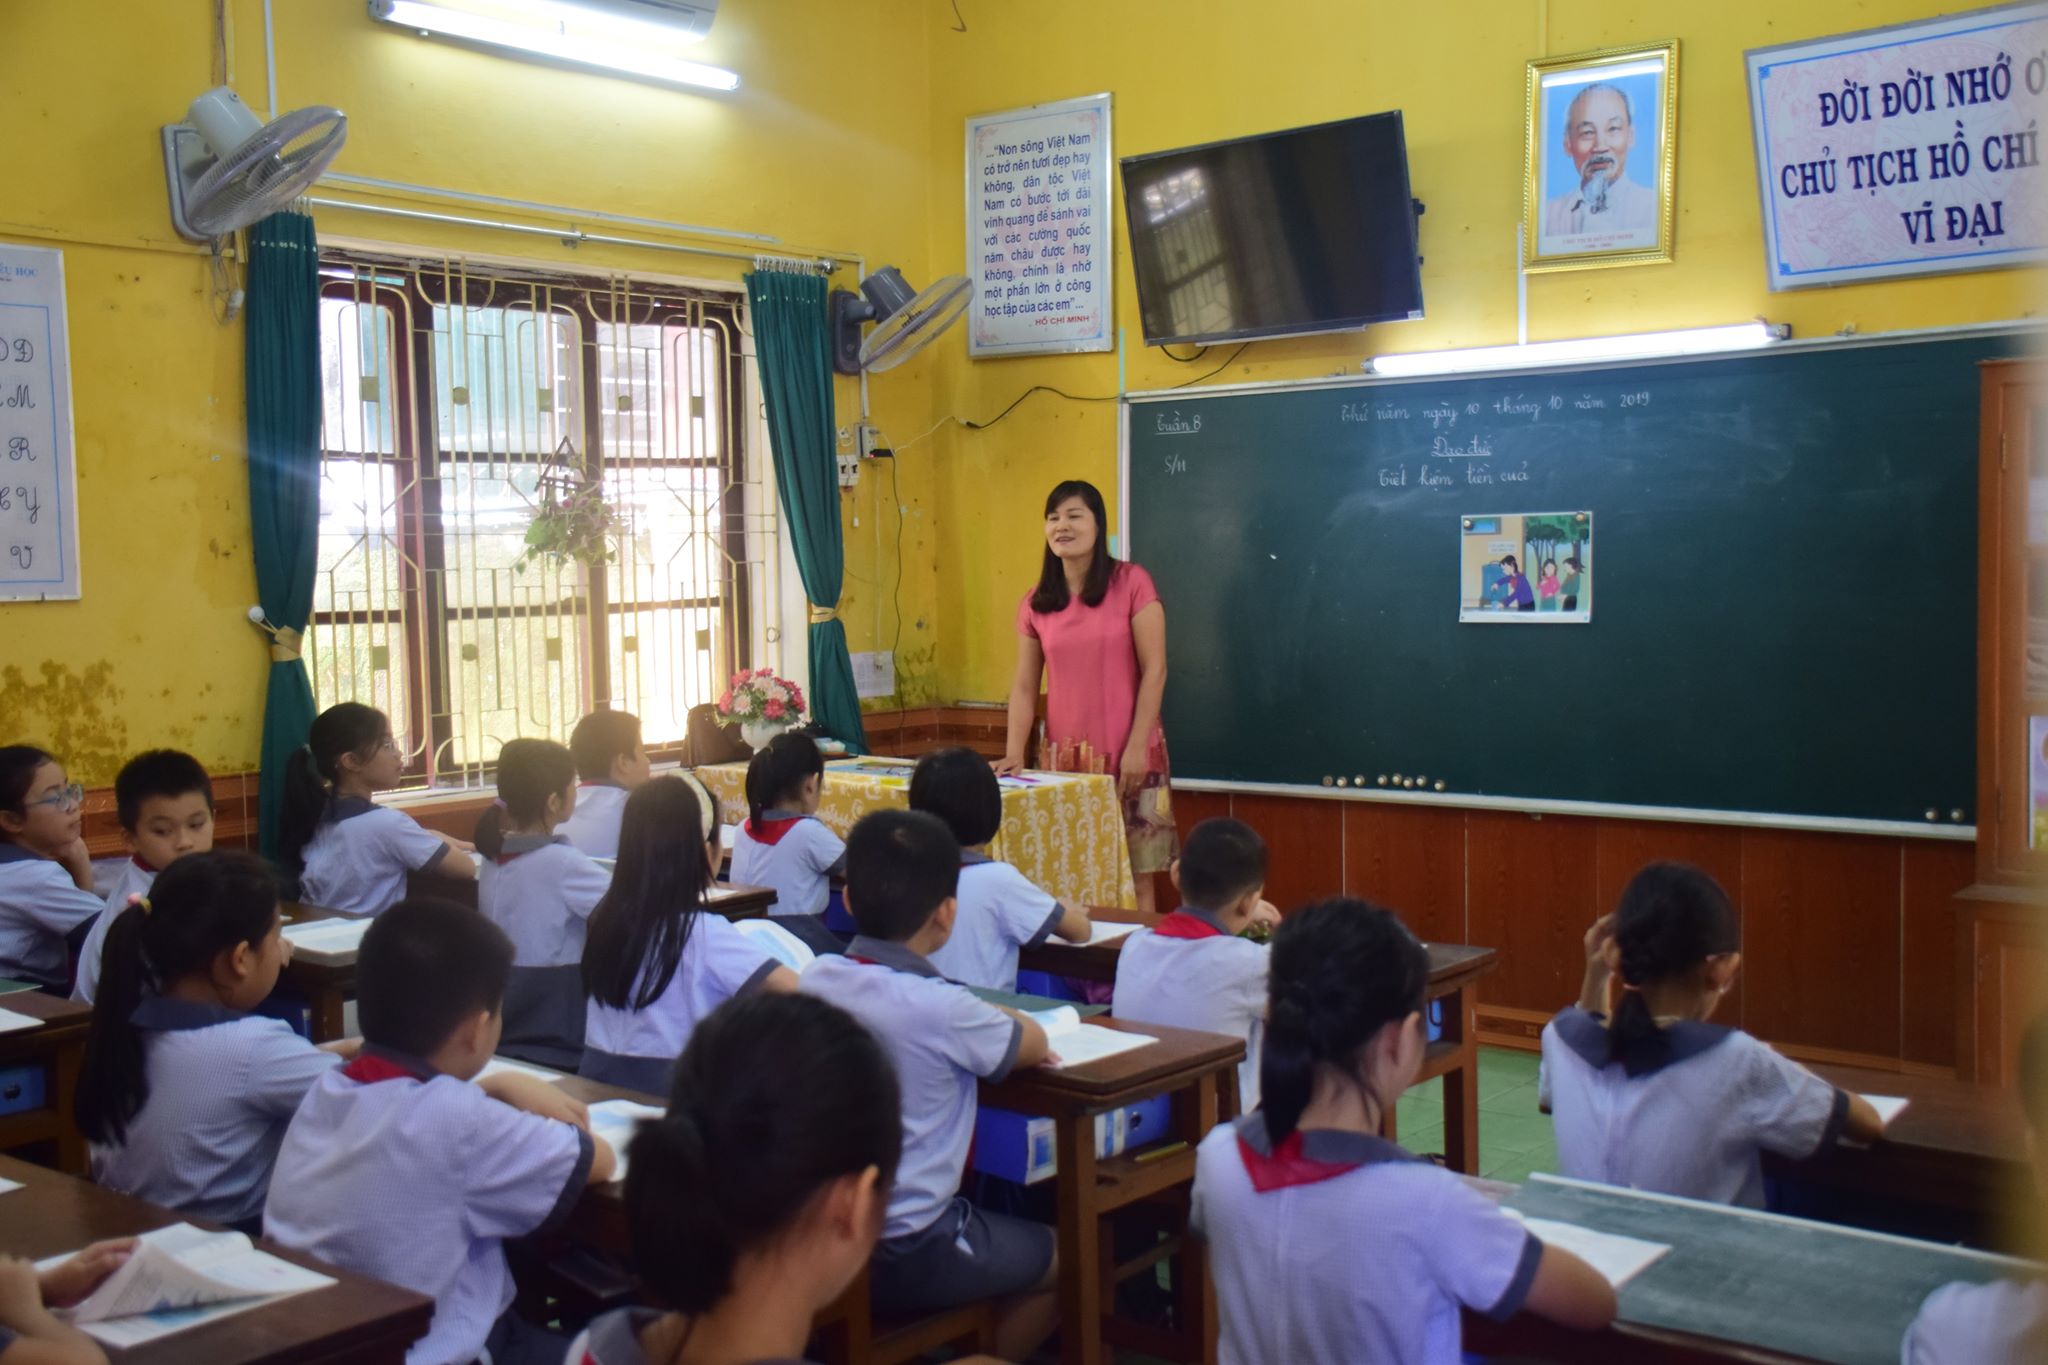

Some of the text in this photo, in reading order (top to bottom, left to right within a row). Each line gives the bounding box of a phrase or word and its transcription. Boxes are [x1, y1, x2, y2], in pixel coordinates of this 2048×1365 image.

[1819, 79, 1872, 127] ĐỜI
[1880, 68, 1936, 118] ĐỜI
[1946, 52, 2012, 108] NHỚ
[1020, 140, 1044, 153] sông
[1047, 136, 1065, 151] Việt
[1068, 133, 1091, 146] Nam
[984, 152, 1091, 176] có trở nên tươi đẹp hay
[1781, 119, 2039, 198] CHỦ TỊCH HỒ CHÍ
[1023, 176, 1040, 188] dân
[1048, 172, 1064, 188] tộc
[1072, 168, 1091, 184] Việt
[984, 199, 1005, 211] Nam
[1010, 196, 1022, 208] có
[1027, 192, 1051, 205] bước
[1057, 188, 1070, 202] tới
[984, 205, 1091, 229] vinh quang để sánh vai
[1901, 201, 2004, 246] VĨ ĐẠI
[984, 222, 1091, 246] với các cường quốc
[984, 243, 1091, 264] năm châu được hay
[1022, 264, 1049, 278] chính
[1056, 262, 1064, 274] là
[1072, 260, 1092, 273] nhờ
[984, 279, 1091, 301] một phần lớn ở công
[984, 305, 1001, 319] học
[1003, 303, 1017, 317] tập
[1019, 300, 1036, 313] của
[1037, 299, 1054, 312] các
[1066, 315, 1090, 323] MINH
[1156, 410, 1201, 432] Tuần 8
[1341, 392, 1649, 428] Thứ năm ngày 10 tháng 10 năm 2019
[1466, 462, 1493, 485] tiền
